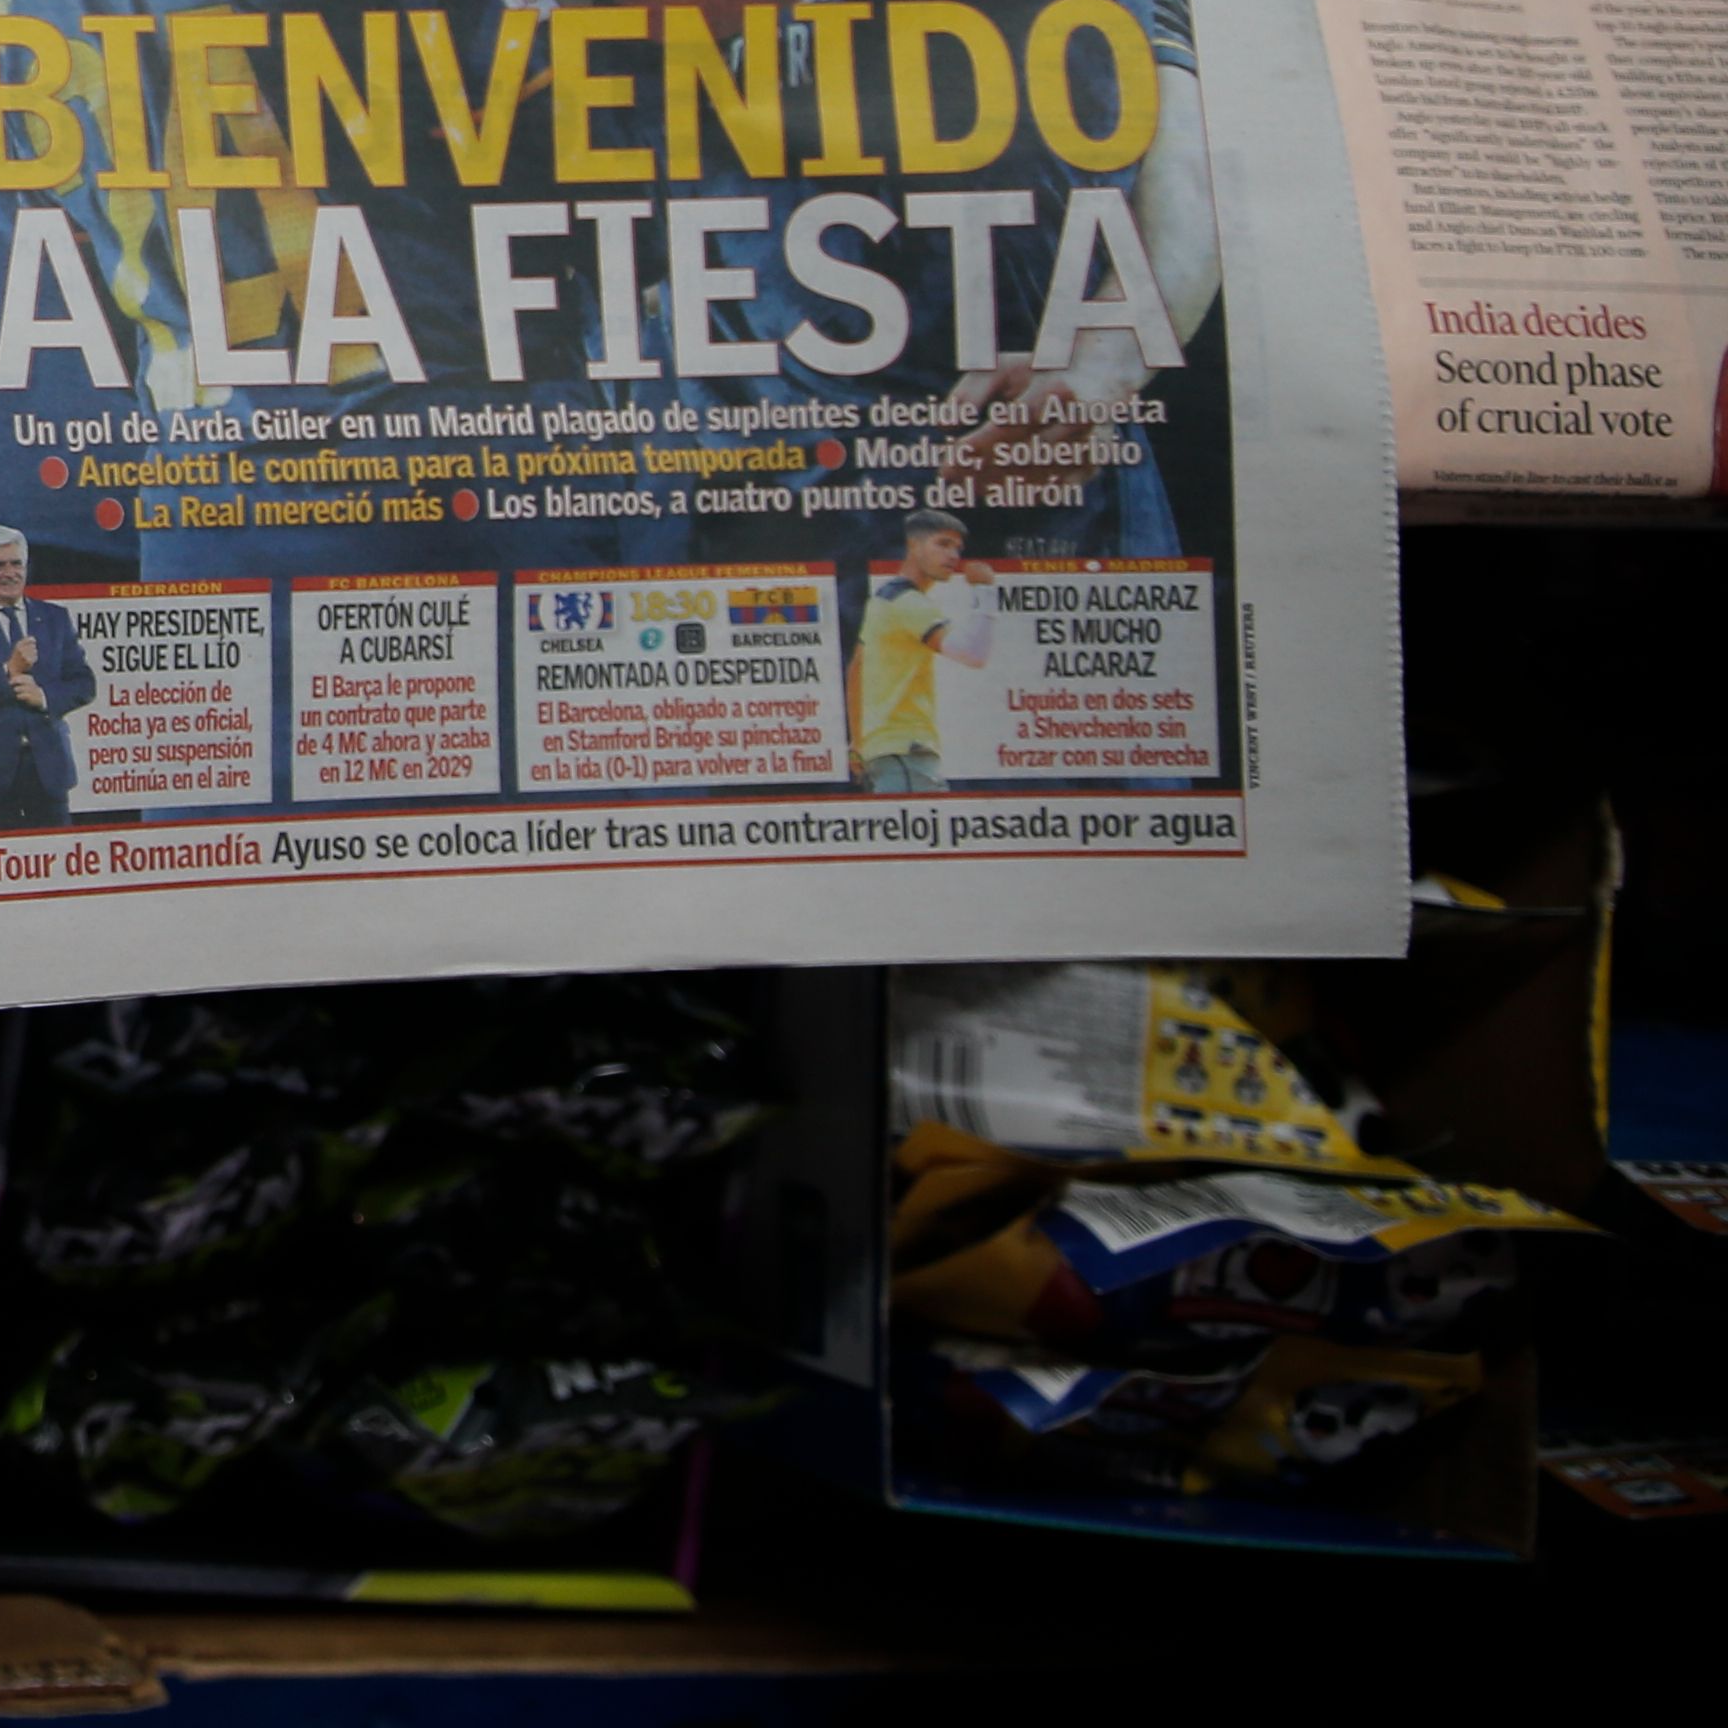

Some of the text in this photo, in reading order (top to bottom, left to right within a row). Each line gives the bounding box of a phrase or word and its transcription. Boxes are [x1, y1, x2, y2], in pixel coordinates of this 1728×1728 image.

[176, 203, 428, 390] LA
[470, 186, 1187, 385] FIESTA
[1424, 301, 1647, 341] India decides
[1435, 351, 1663, 396] Second phase
[1437, 399, 1673, 439] of crucial vote
[77, 606, 265, 640] HAY PRESIDENTE,
[102, 634, 240, 674] SIGUE EL LÍO
[64, 842, 101, 876] de
[108, 833, 262, 873] Romandía
[272, 831, 367, 872] Ayuso
[375, 836, 405, 862] se
[417, 826, 518, 858] coloca
[526, 818, 596, 853] líder
[605, 814, 669, 850] tras
[677, 818, 736, 847] una
[744, 811, 940, 851] contrarreloj
[949, 811, 1073, 850] pasada
[1080, 811, 1138, 847] por
[1148, 808, 1236, 846] agua
